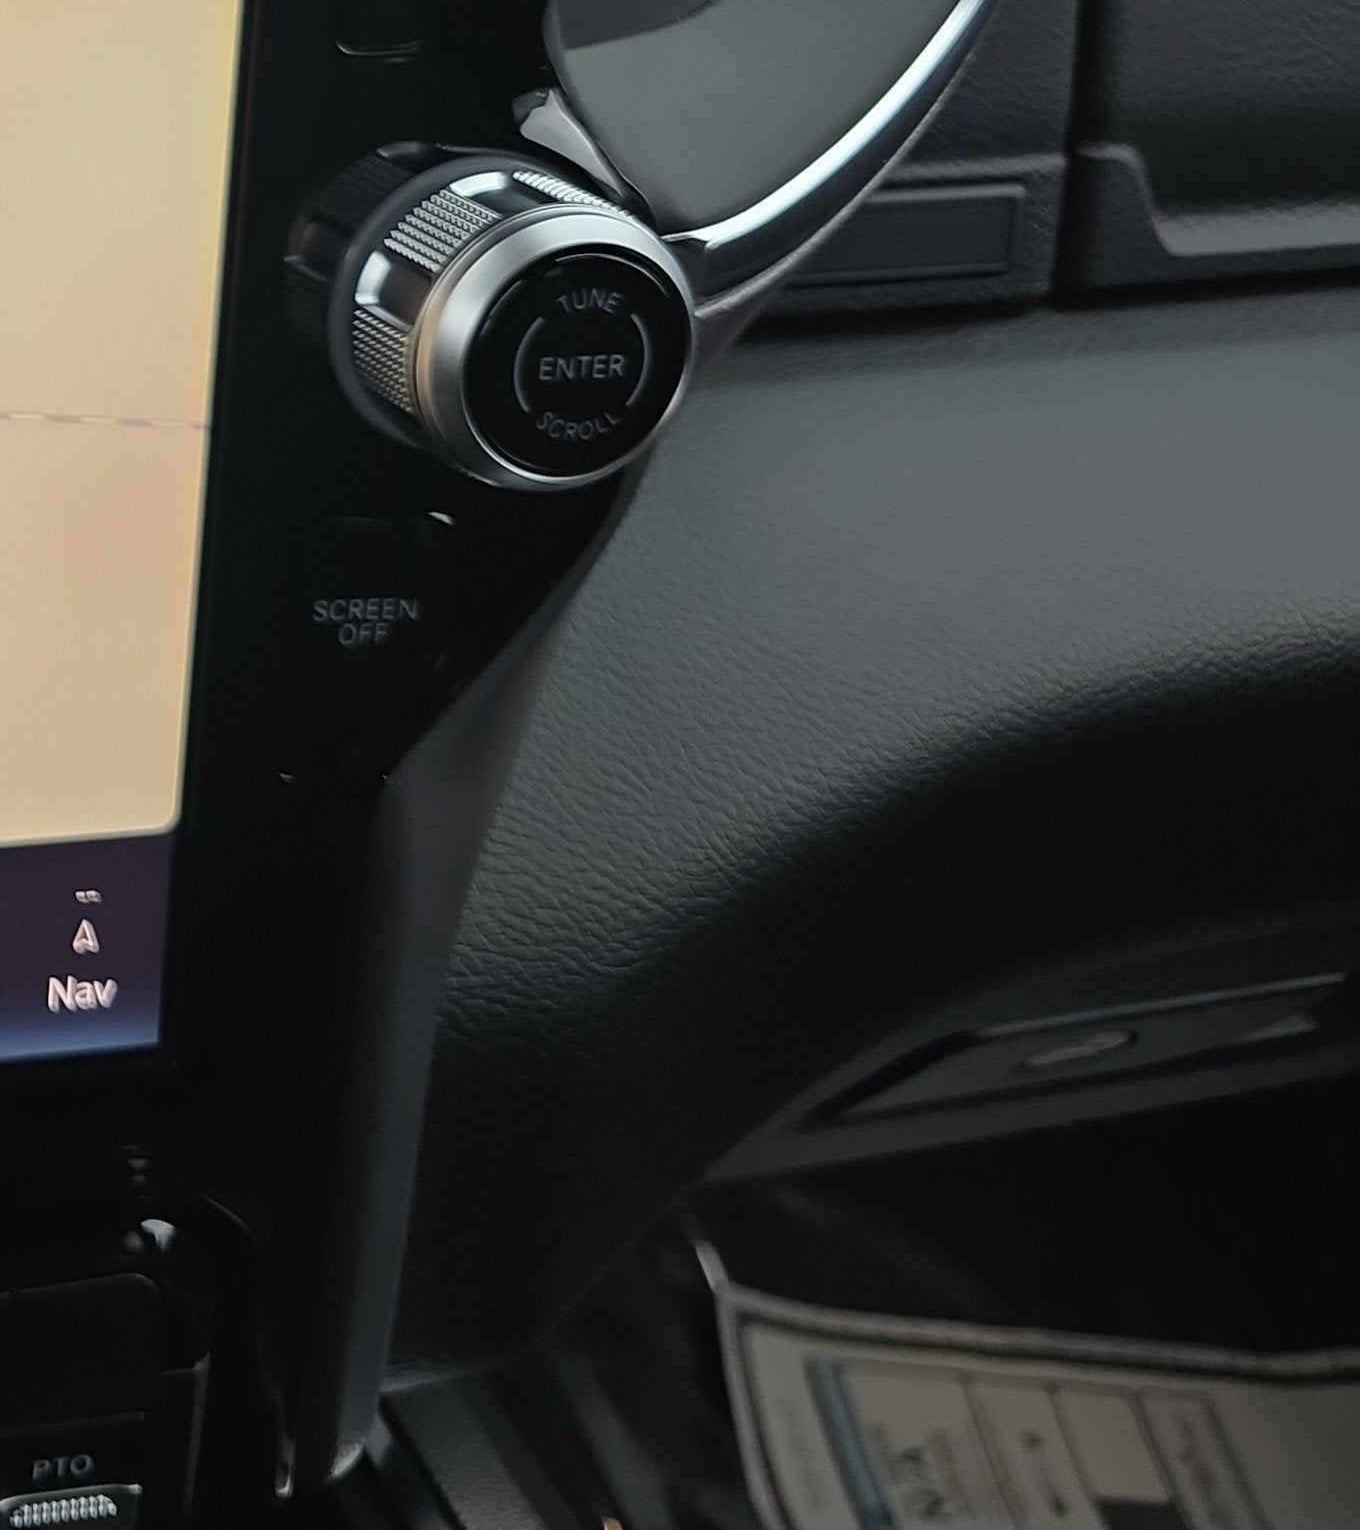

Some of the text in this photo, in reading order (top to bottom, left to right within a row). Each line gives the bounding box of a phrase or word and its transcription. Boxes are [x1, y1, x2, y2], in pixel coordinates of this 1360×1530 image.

[555, 286, 624, 318] TUNE
[537, 352, 628, 384] ENTER
[534, 410, 622, 444] SCROLL
[312, 595, 423, 628] SCREEN
[337, 620, 390, 650] OFF
[47, 974, 119, 1014] Nav
[31, 1452, 96, 1481] PTO
